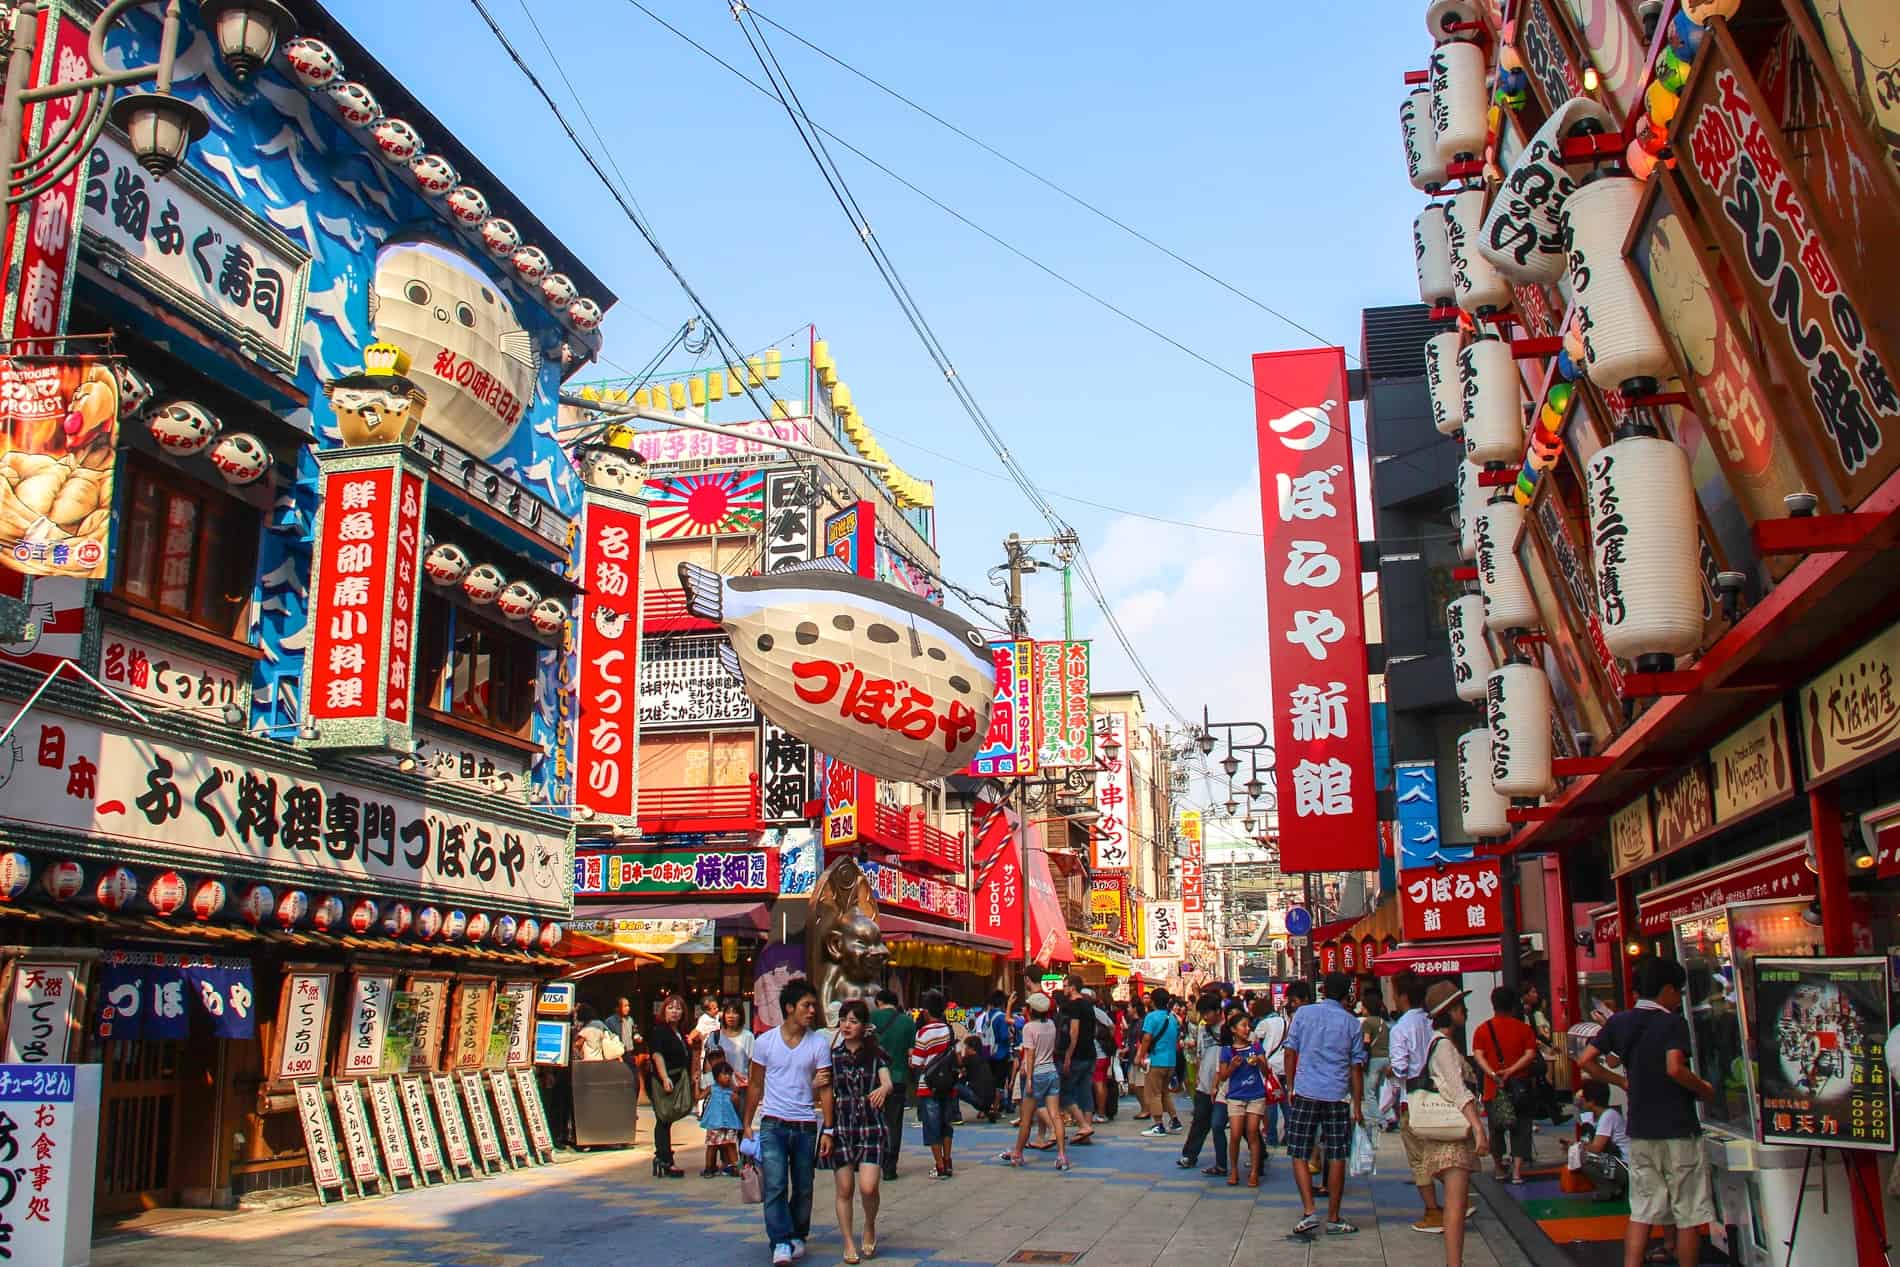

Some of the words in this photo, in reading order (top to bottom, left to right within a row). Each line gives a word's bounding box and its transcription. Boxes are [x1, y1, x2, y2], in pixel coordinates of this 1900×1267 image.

[0, 397, 63, 414] PROJECT
[327, 480, 377, 710] 鮮魚即席小料理
[597, 525, 630, 597] 名物
[1269, 399, 1353, 817] づぼらや新館
[588, 650, 625, 799] てっちり
[791, 659, 978, 753] づぼらや
[135, 752, 525, 887] ふぐ料理専門づぼらや
[621, 861, 693, 884] 日本一の串かつ
[695, 853, 749, 888] 横綱
[750, 855, 765, 887] 酒処
[1407, 869, 1498, 904] づぼらや
[542, 995, 565, 1003] VISA
[353, 1055, 373, 1066] 840
[24, 1103, 56, 1221] お食事処
